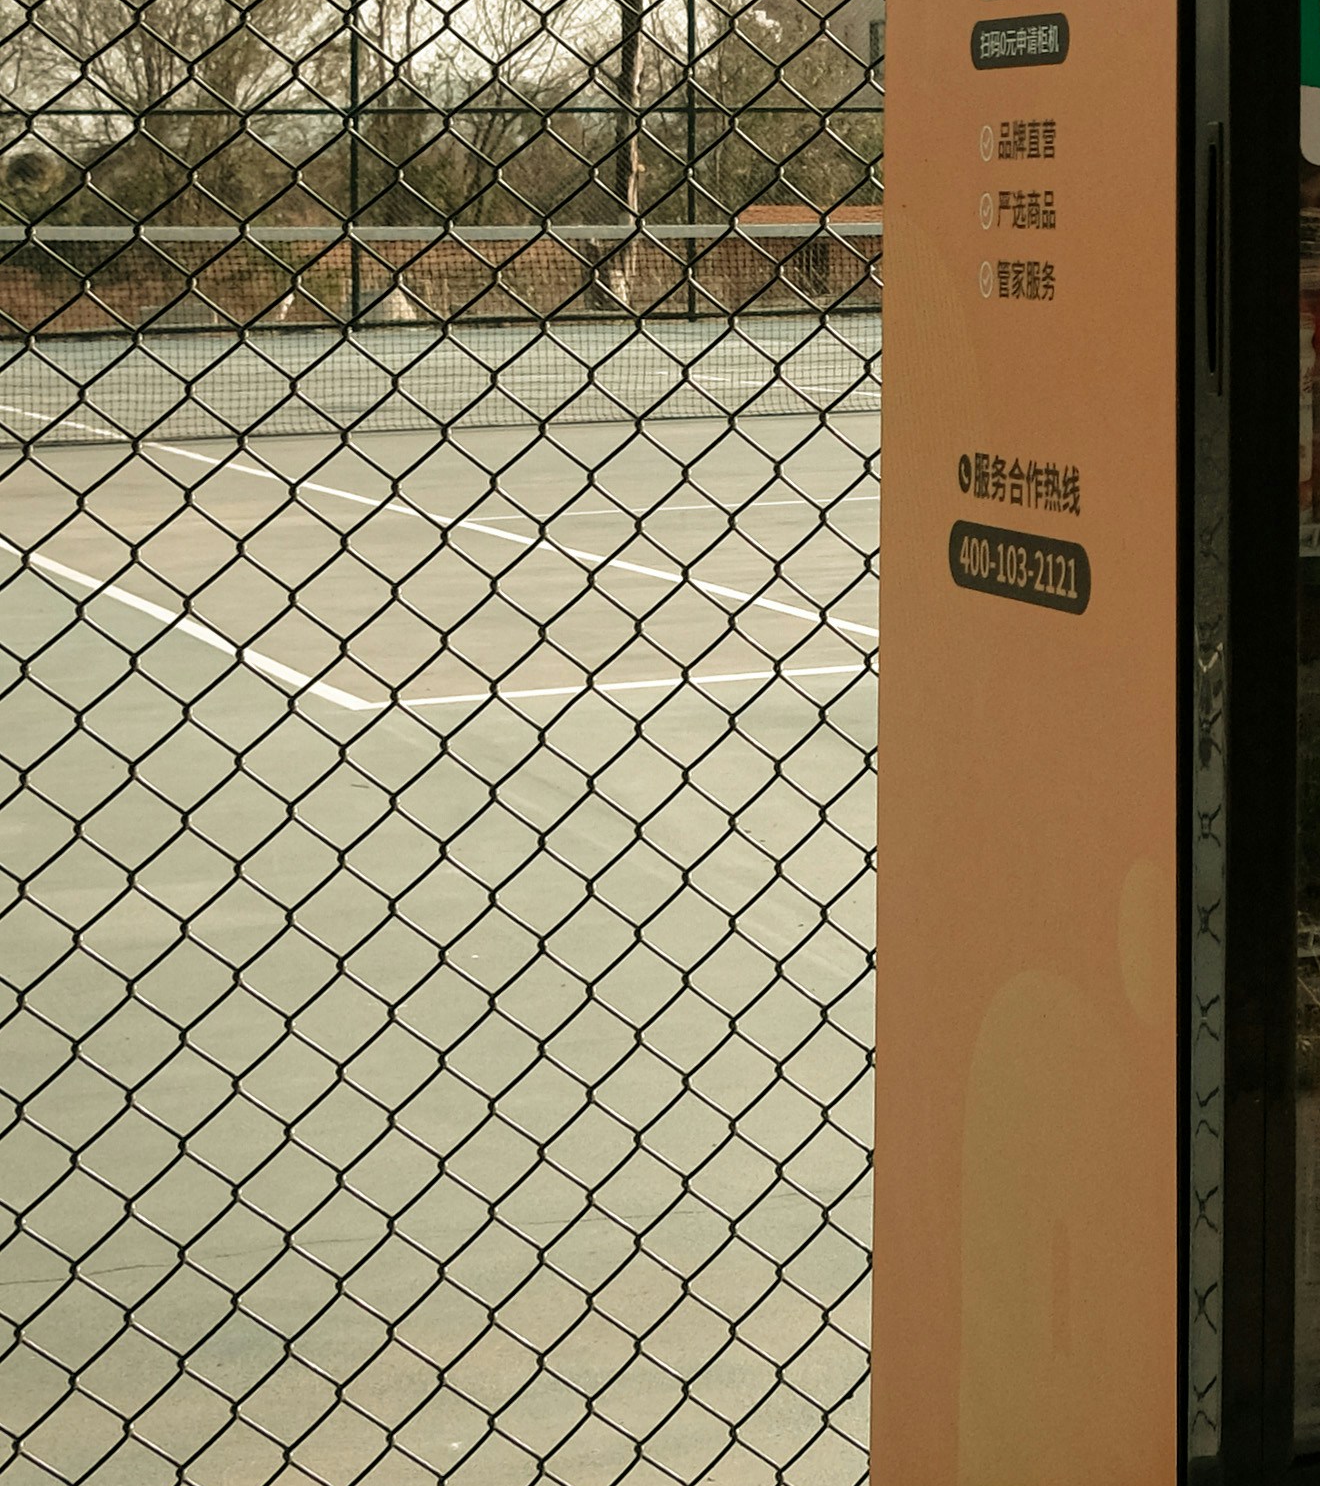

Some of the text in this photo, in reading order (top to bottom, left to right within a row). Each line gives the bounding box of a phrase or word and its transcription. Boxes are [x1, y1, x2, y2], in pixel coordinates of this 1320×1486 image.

[998, 120, 1056, 160] 品牌直营
[997, 190, 1056, 230] 严选商品
[997, 260, 1056, 301] 管家服务
[973, 452, 1081, 517] 服务合作热线
[959, 535, 1078, 599] 400-103-2121
